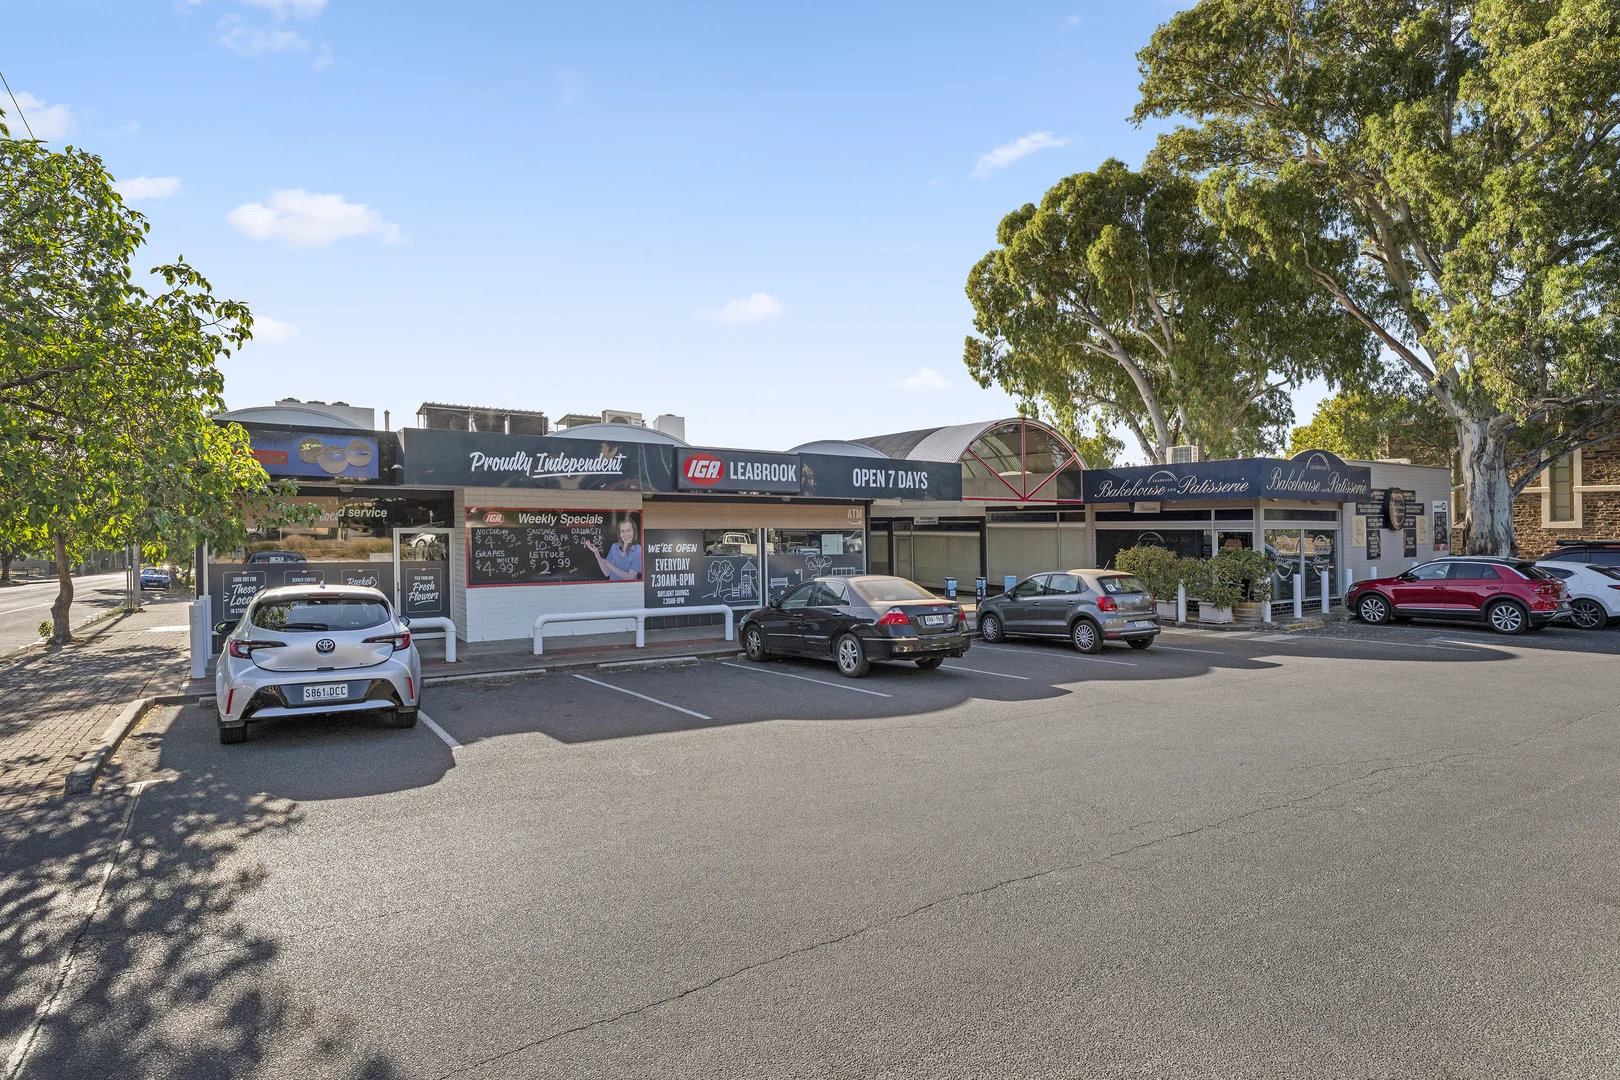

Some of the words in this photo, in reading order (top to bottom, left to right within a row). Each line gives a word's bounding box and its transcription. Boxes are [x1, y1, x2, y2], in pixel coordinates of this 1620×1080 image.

[469, 451, 533, 476] Proudly
[534, 452, 627, 478] Independent
[687, 459, 721, 479] IGA
[729, 461, 797, 482] LEABROOK
[852, 467, 886, 488] OPEN
[888, 468, 895, 488] 7
[897, 471, 928, 490] DAYS
[1267, 467, 1321, 493] Bakehouse
[1328, 471, 1368, 495] Patisserie
[1095, 479, 1166, 498] Bakehouse
[1177, 475, 1249, 495] Patisserie
[348, 507, 388, 518] service
[486, 514, 503, 523] IGA
[847, 508, 863, 519] ATM
[519, 513, 558, 526] Weekly
[560, 514, 604, 526] Specials
[526, 528, 556, 536] SAUSAGE
[475, 549, 505, 558] GRAPES
[648, 542, 673, 554] WE'RE
[675, 543, 698, 553] OPEN
[496, 556, 519, 564] WHITE
[529, 550, 565, 559] LETTUCE
[655, 558, 691, 572] EVERYDAY
[412, 581, 436, 592] Fresh
[651, 573, 695, 588] 7.30AM-8PM
[231, 583, 257, 595] These
[230, 594, 253, 607] Loca
[408, 592, 439, 602] Flowers
